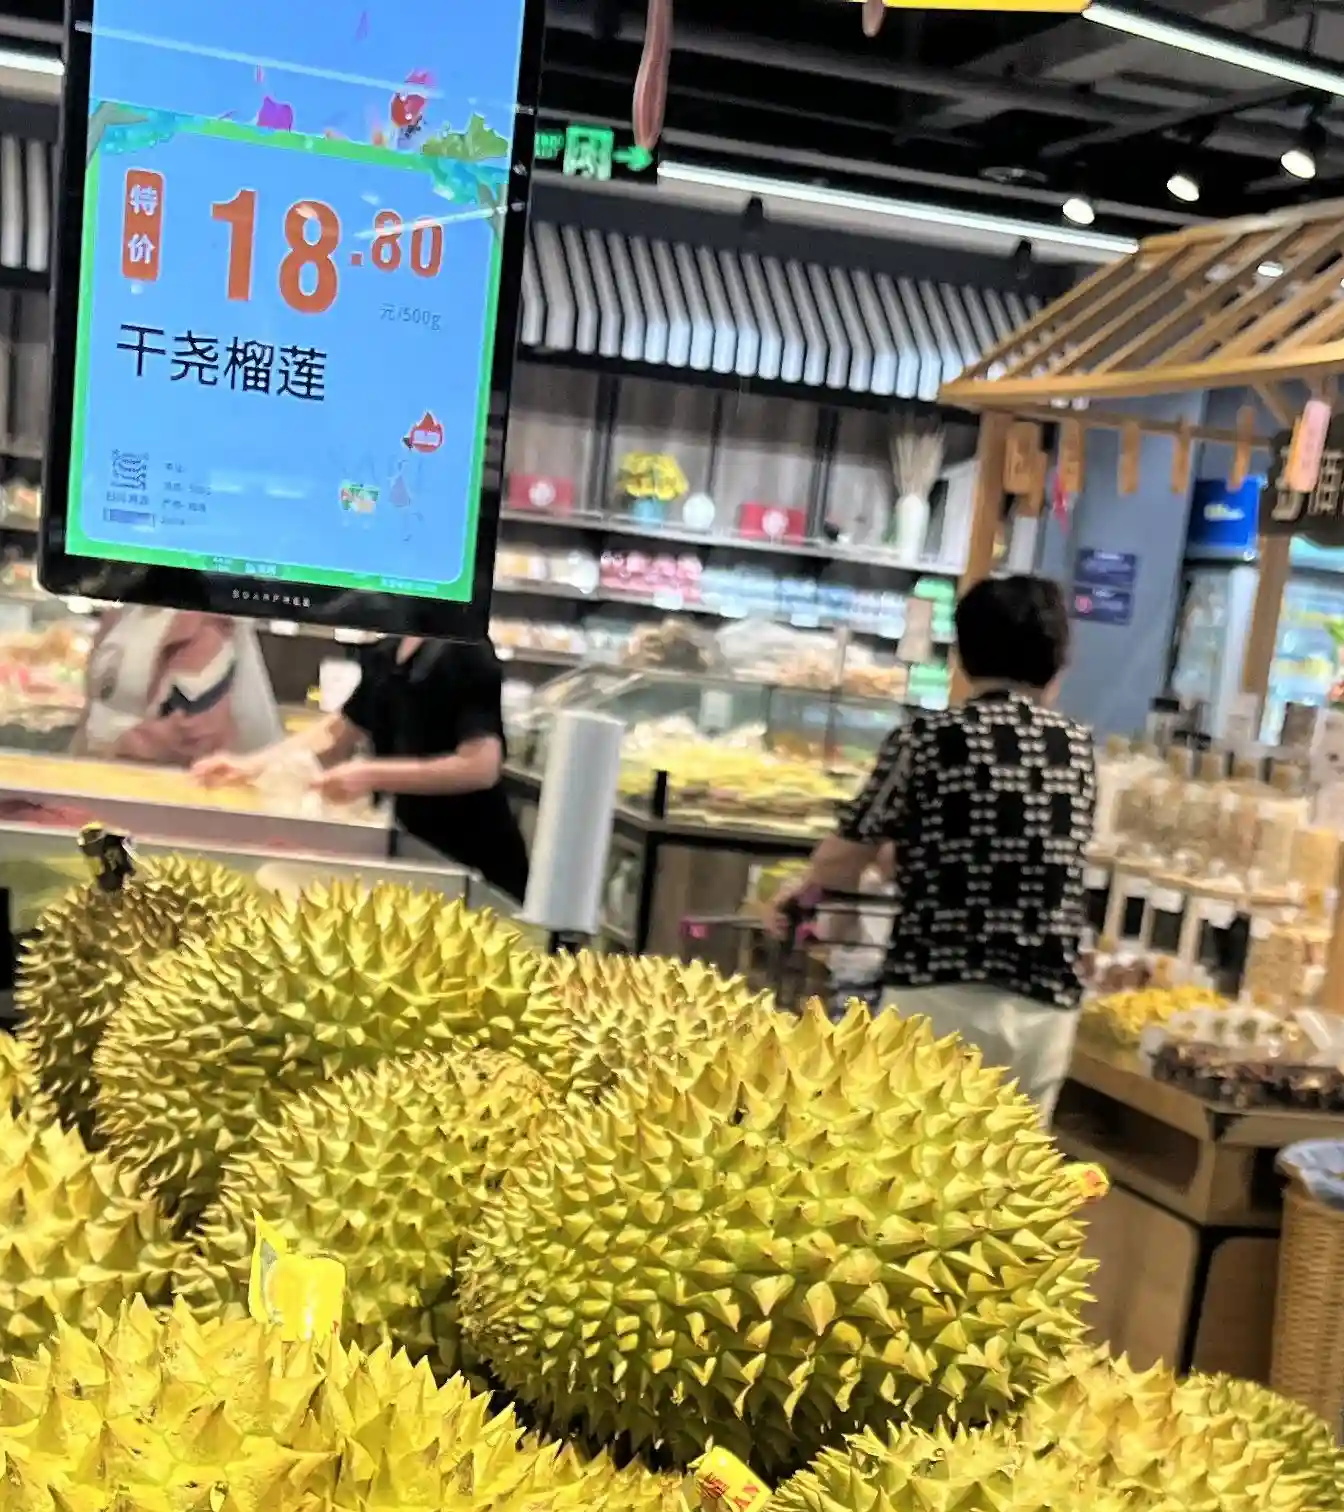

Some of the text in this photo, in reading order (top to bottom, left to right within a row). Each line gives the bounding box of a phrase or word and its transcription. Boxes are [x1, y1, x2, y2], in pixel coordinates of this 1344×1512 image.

[127, 183, 159, 265] 特价
[210, 187, 445, 314] 18.80
[117, 323, 329, 402] 干尧榴莲
